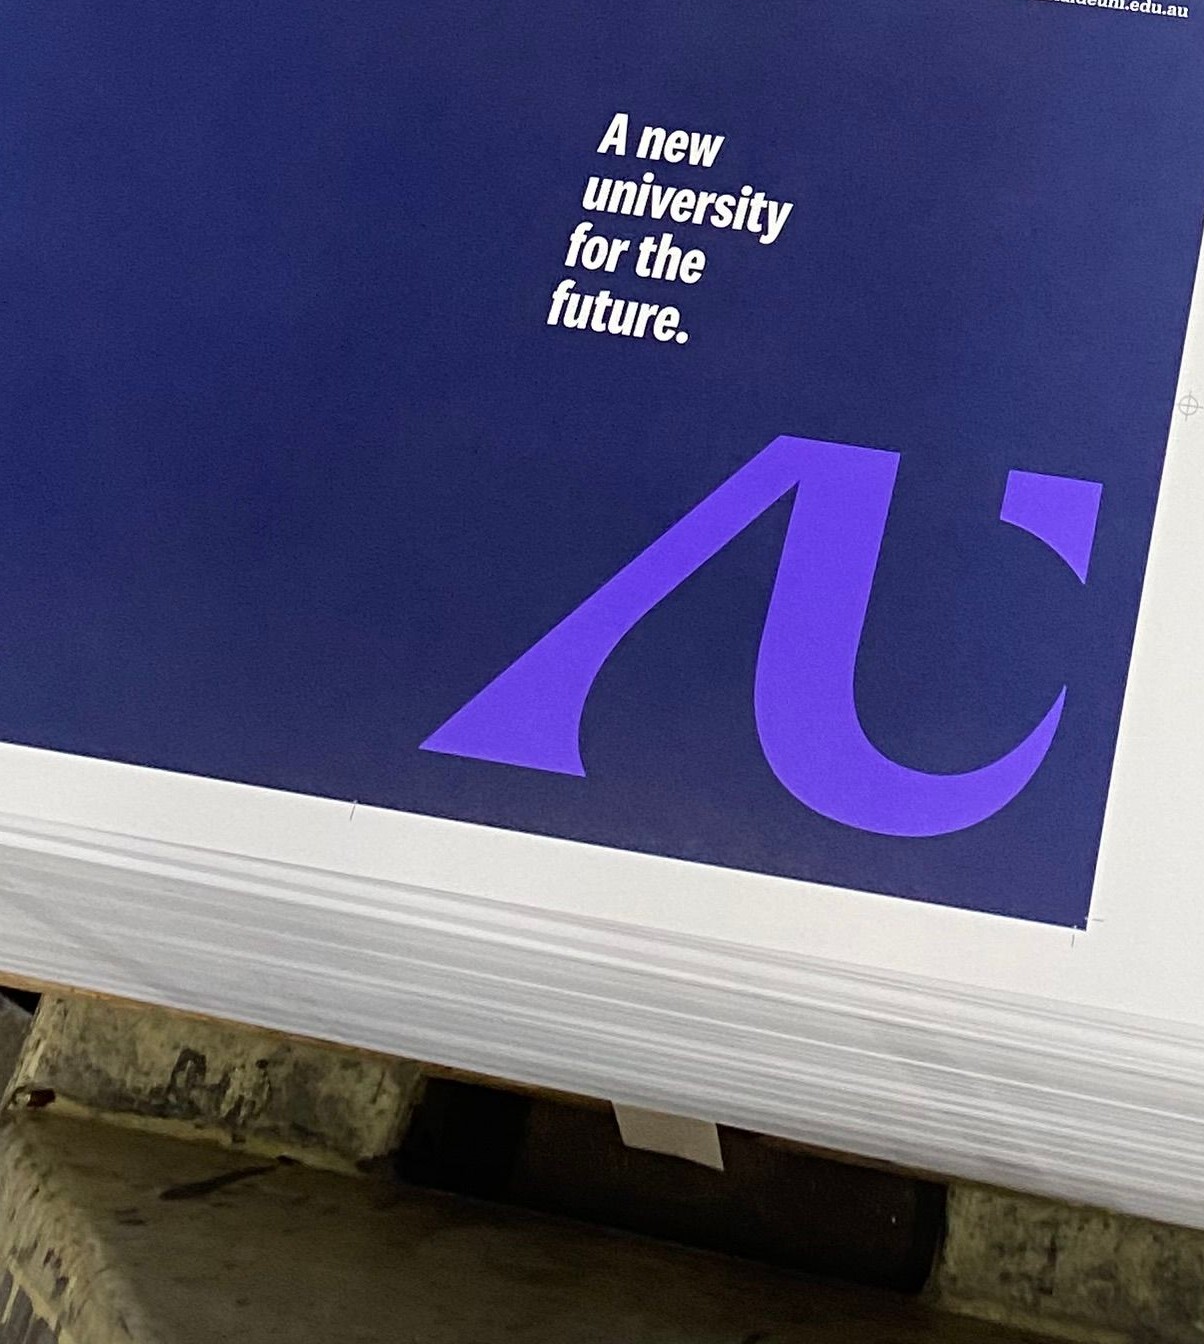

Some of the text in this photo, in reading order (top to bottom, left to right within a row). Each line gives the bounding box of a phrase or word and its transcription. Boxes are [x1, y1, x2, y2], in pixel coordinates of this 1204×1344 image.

[597, 112, 726, 168] A new
[582, 172, 794, 245] university
[564, 221, 707, 284] for the
[547, 278, 689, 345] future.
